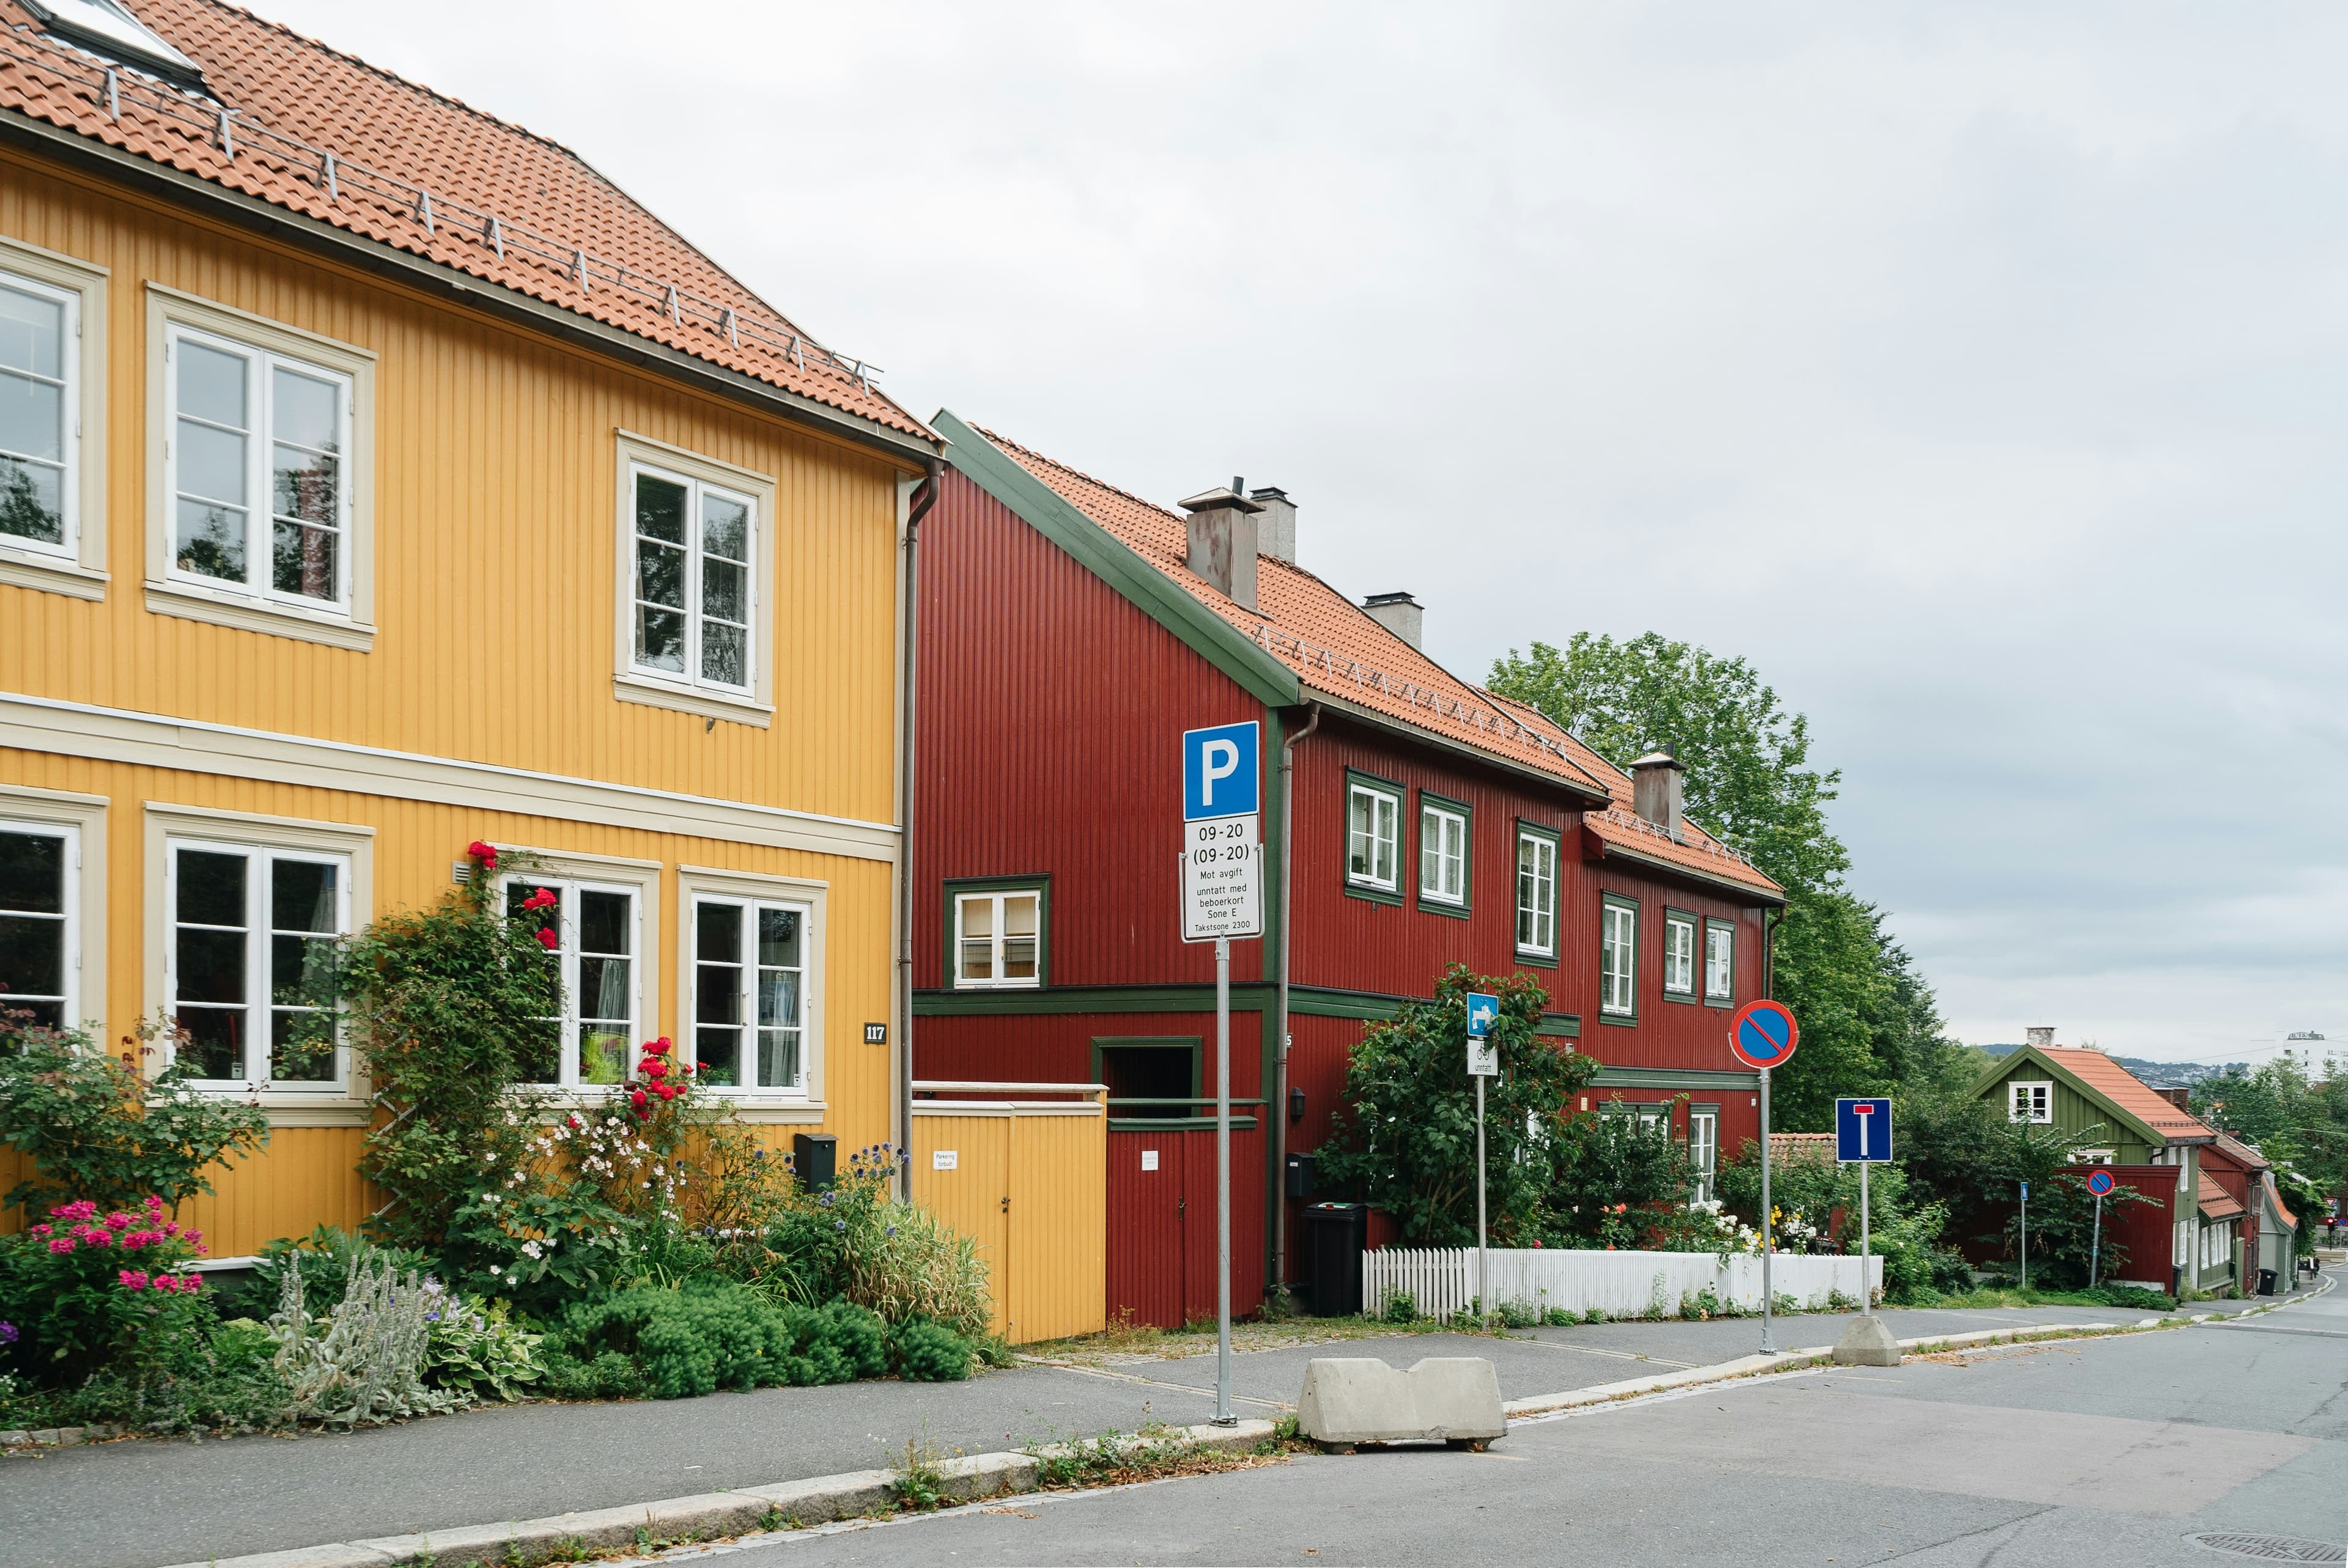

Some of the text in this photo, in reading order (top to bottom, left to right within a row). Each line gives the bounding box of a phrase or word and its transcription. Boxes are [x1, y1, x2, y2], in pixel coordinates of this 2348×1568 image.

[1202, 738, 1239, 806] P
[1200, 867, 1242, 880] Mot avgift
[1197, 883, 1247, 896] unntatt med
[1200, 896, 1244, 907] beboerkort
[1208, 908, 1236, 919] Sone E
[867, 1026, 885, 1039] 117
